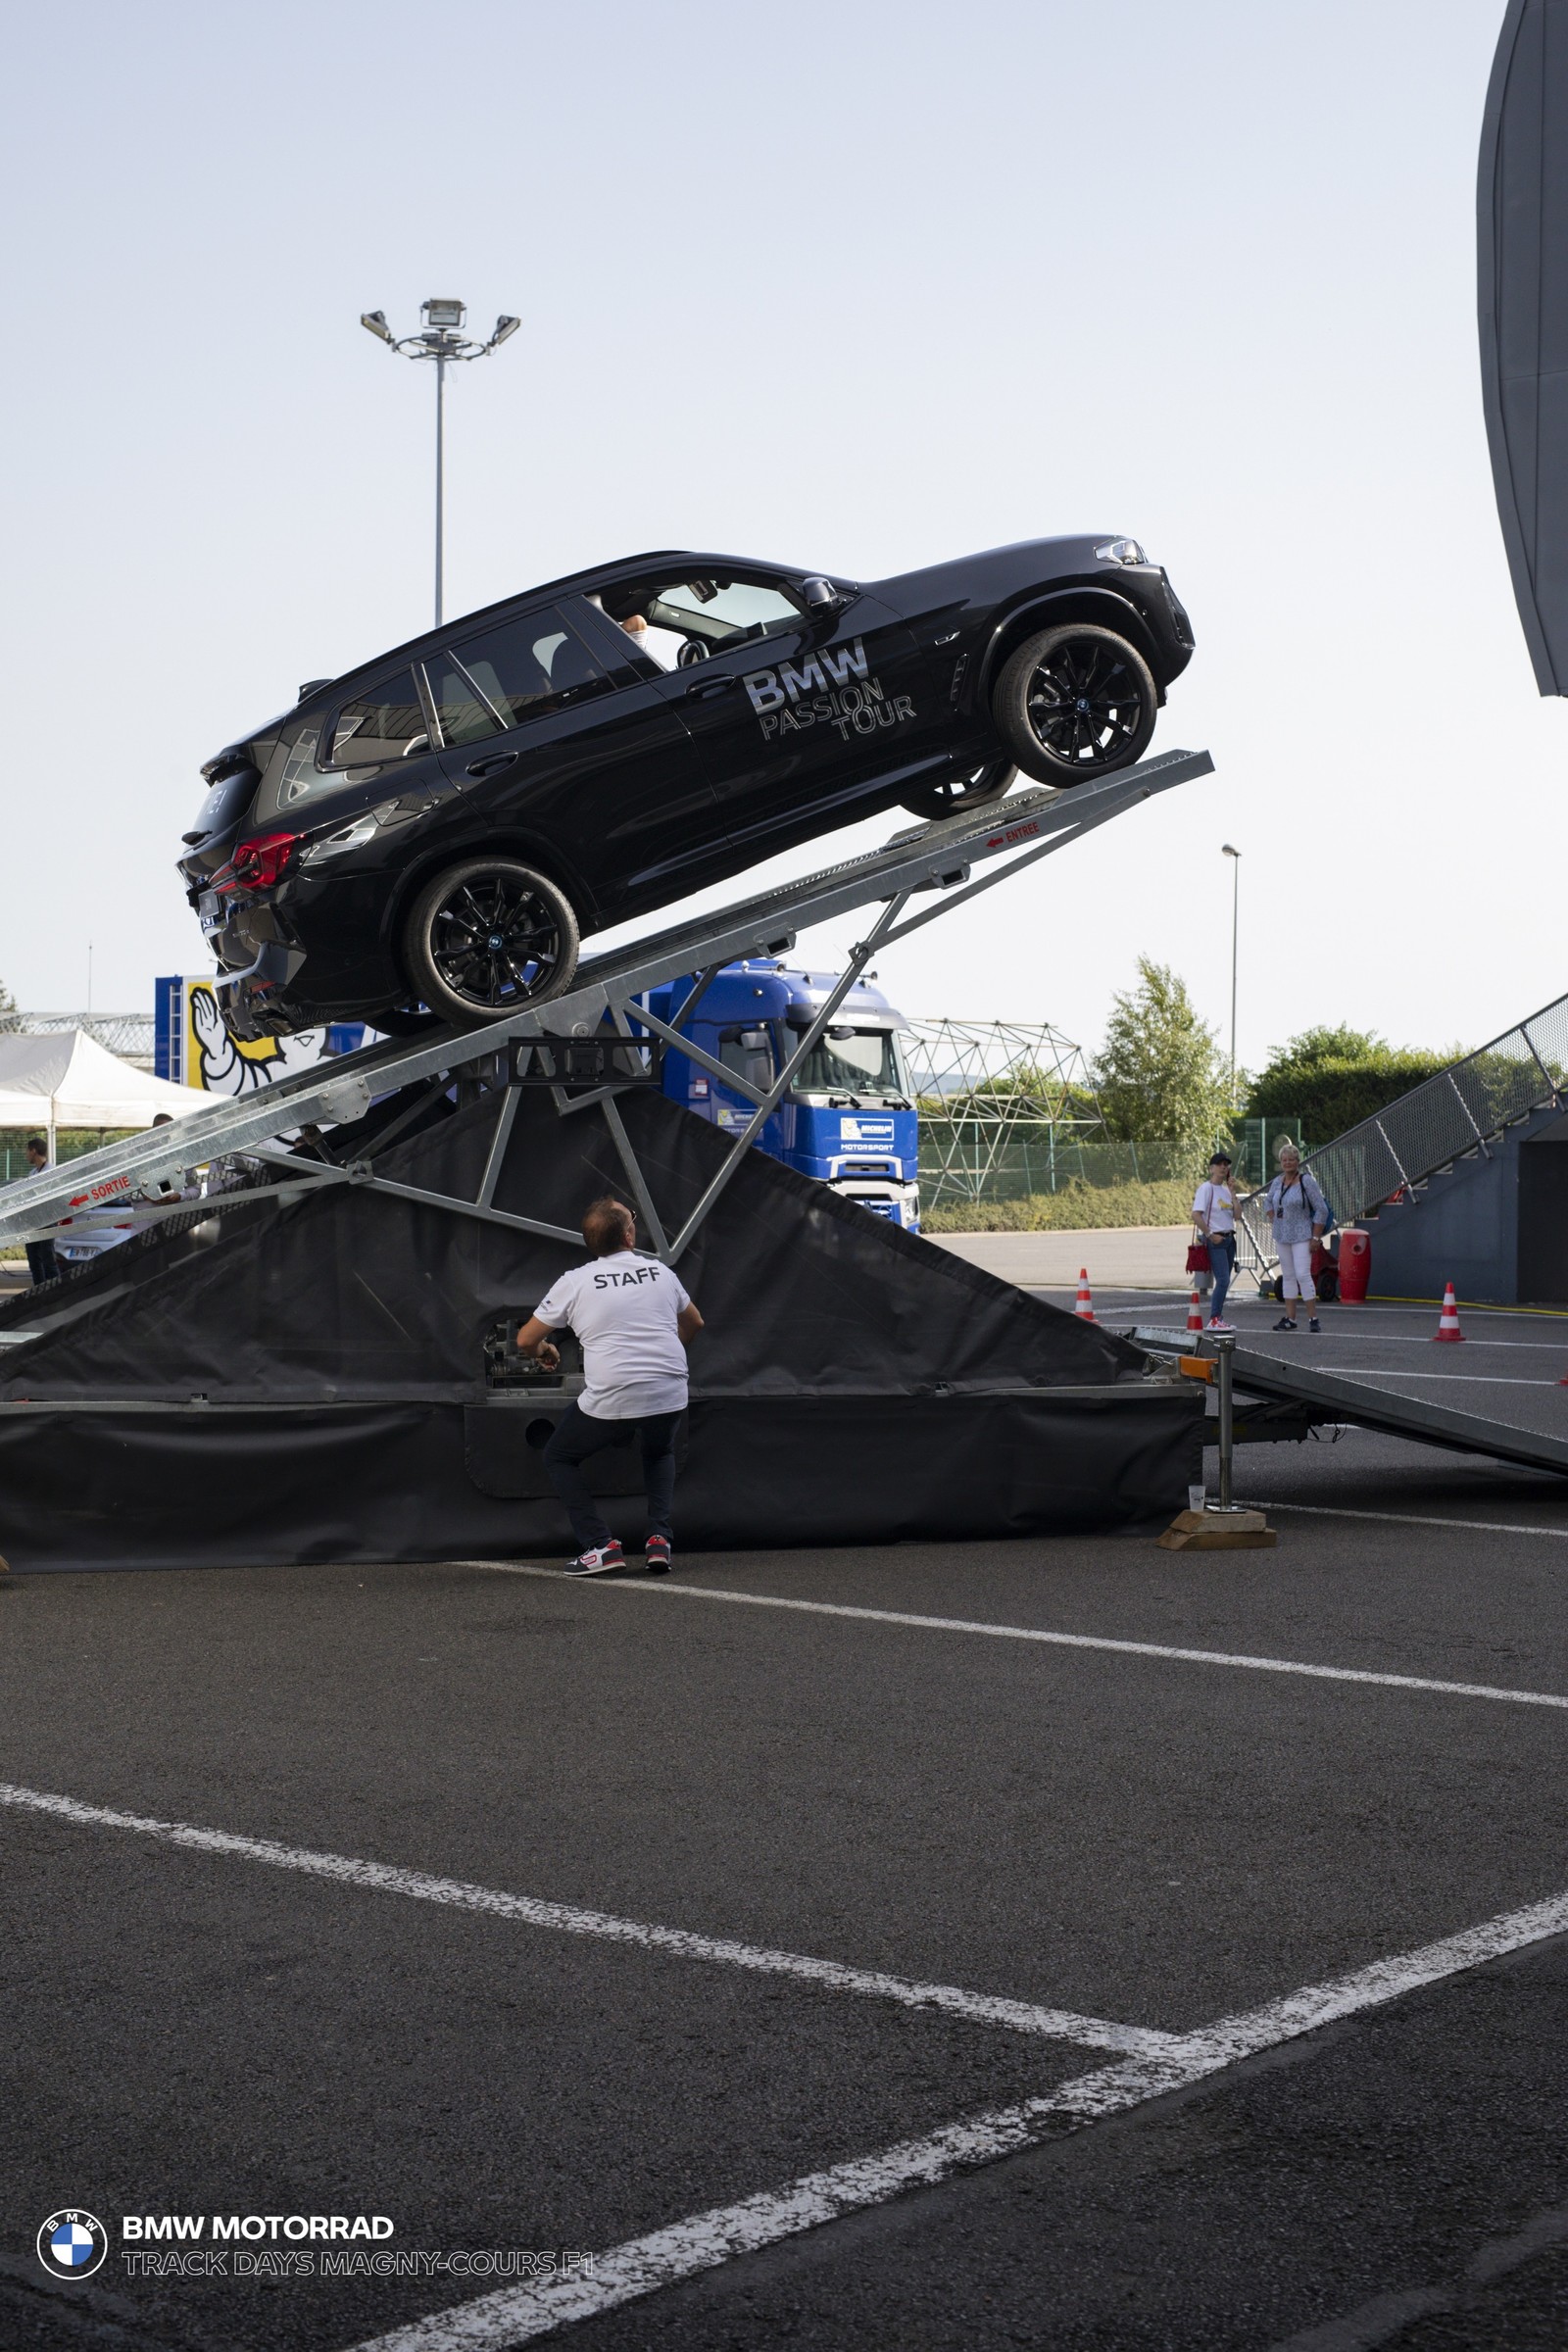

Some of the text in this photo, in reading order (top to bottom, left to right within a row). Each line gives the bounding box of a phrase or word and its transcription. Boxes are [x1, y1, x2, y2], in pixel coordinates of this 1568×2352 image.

[743, 636, 868, 715] BMW
[759, 677, 884, 741] PASSION
[831, 695, 917, 741] TOUR
[1005, 821, 1040, 843] ENTREE
[91, 1175, 131, 1200] SORTIE
[593, 1266, 661, 1290] STAFF
